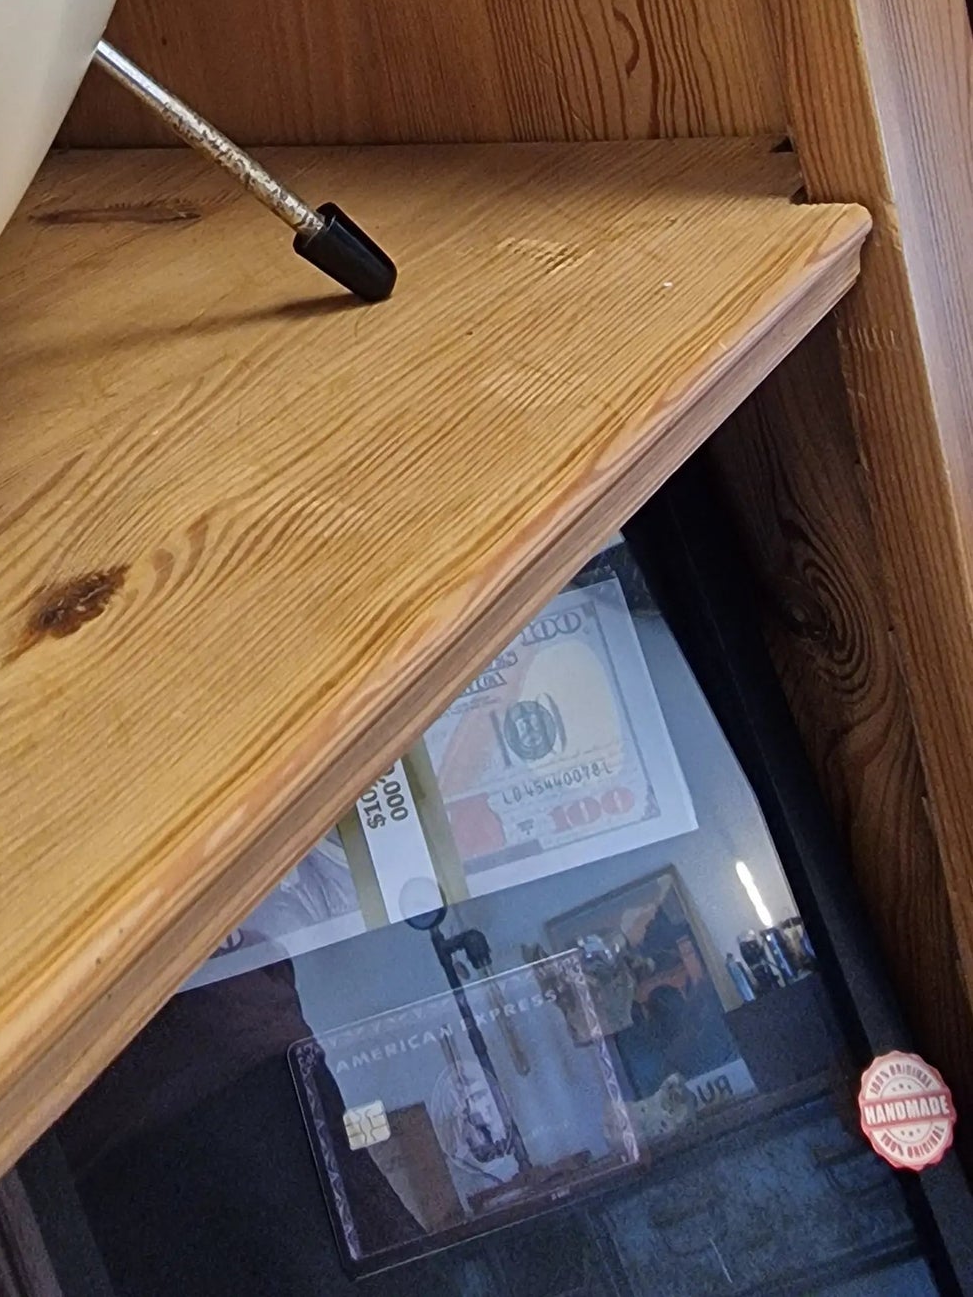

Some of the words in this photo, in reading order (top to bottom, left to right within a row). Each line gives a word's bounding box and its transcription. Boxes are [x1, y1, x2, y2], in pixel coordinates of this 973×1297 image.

[548, 786, 635, 833] 100
[336, 1023, 454, 1074] AMERICAN
[460, 989, 558, 1033] EXPRESS
